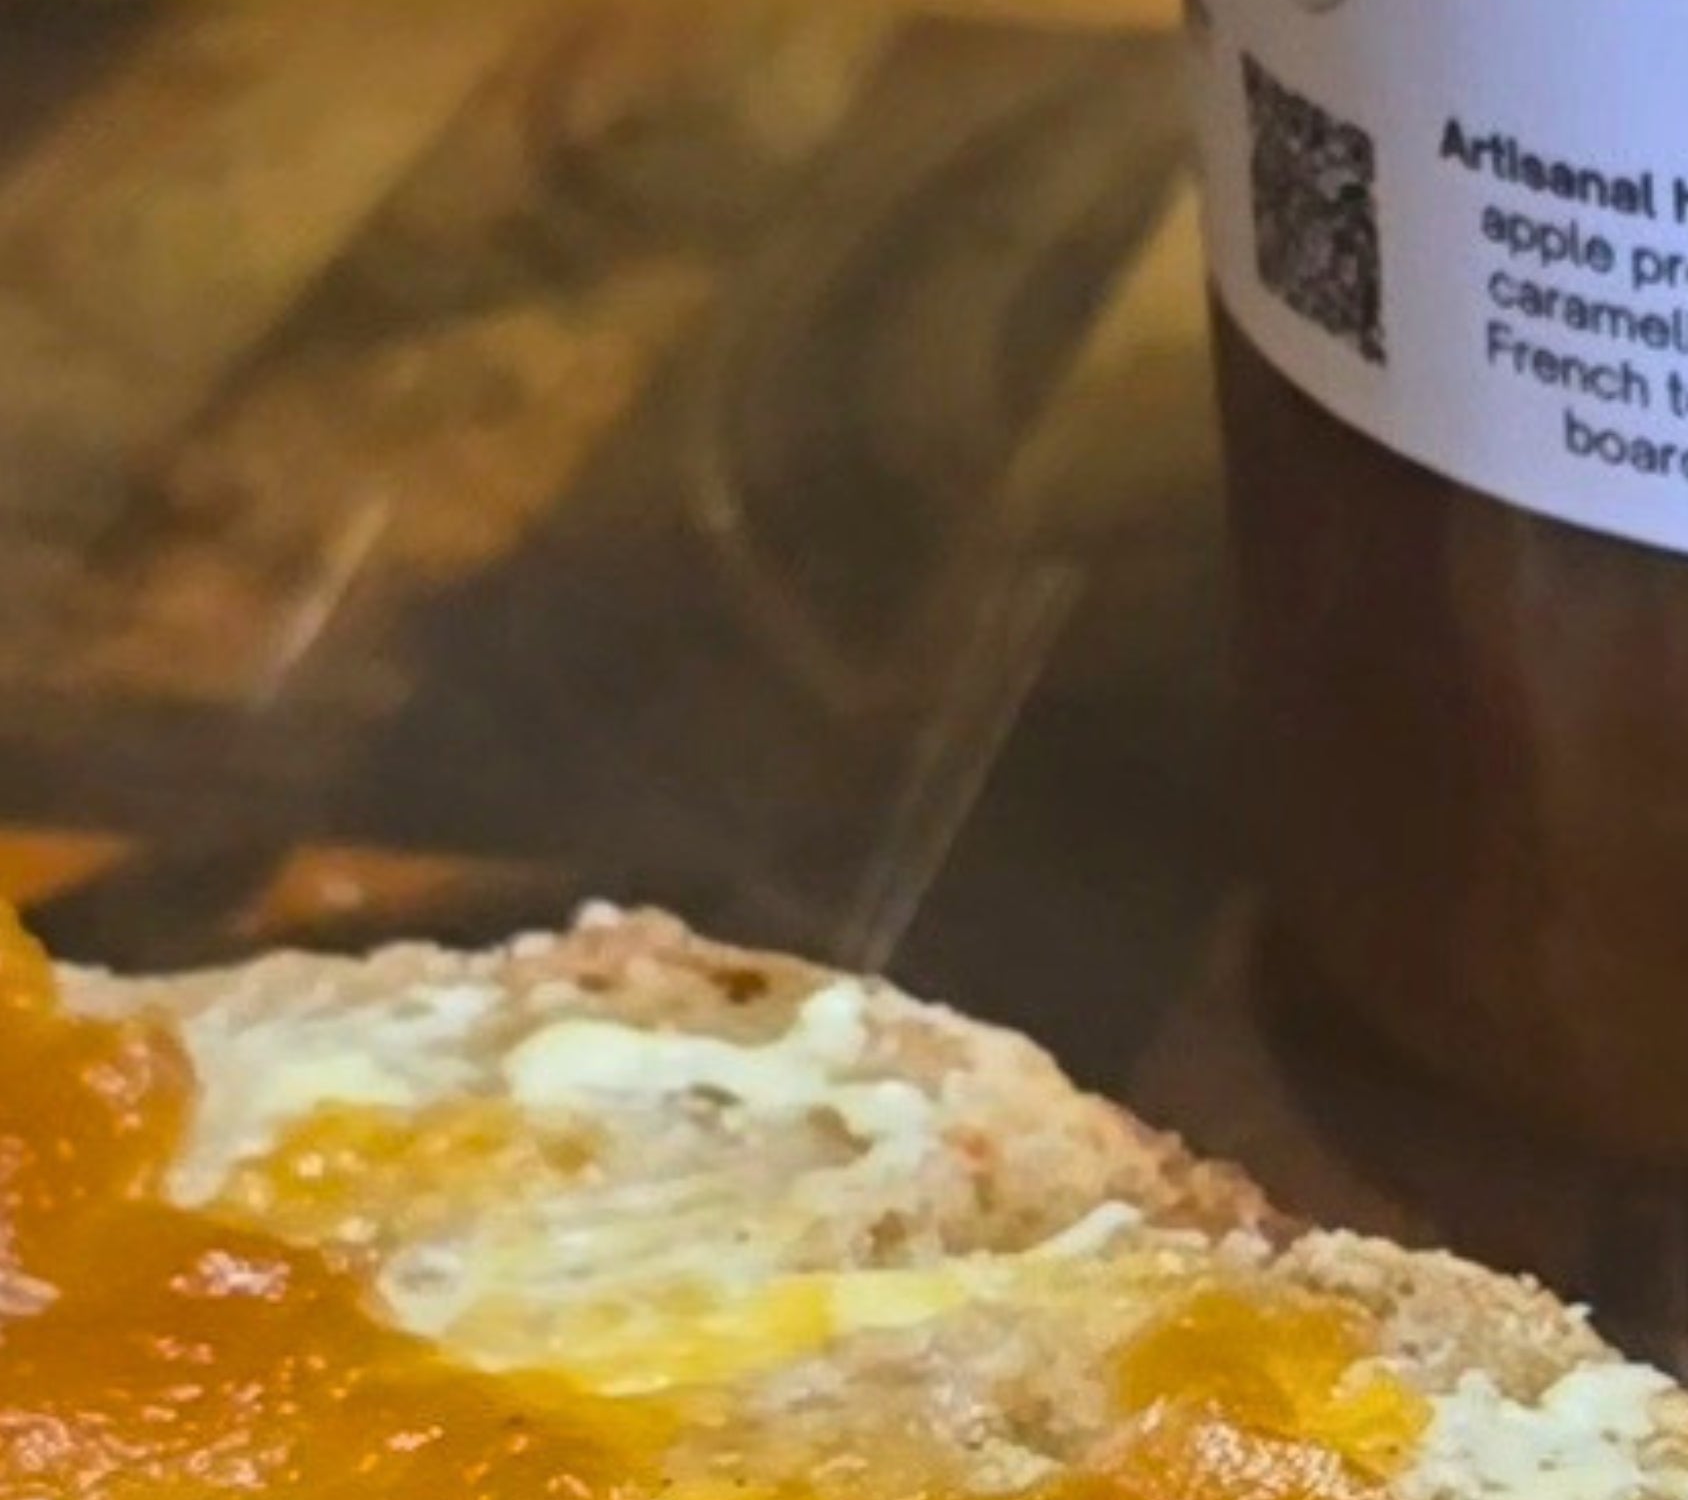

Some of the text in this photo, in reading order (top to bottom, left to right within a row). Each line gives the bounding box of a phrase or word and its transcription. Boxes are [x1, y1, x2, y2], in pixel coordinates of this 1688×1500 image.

[1438, 116, 1657, 220] Artisanal
[1481, 205, 1615, 274] apple
[1485, 320, 1651, 409] French
